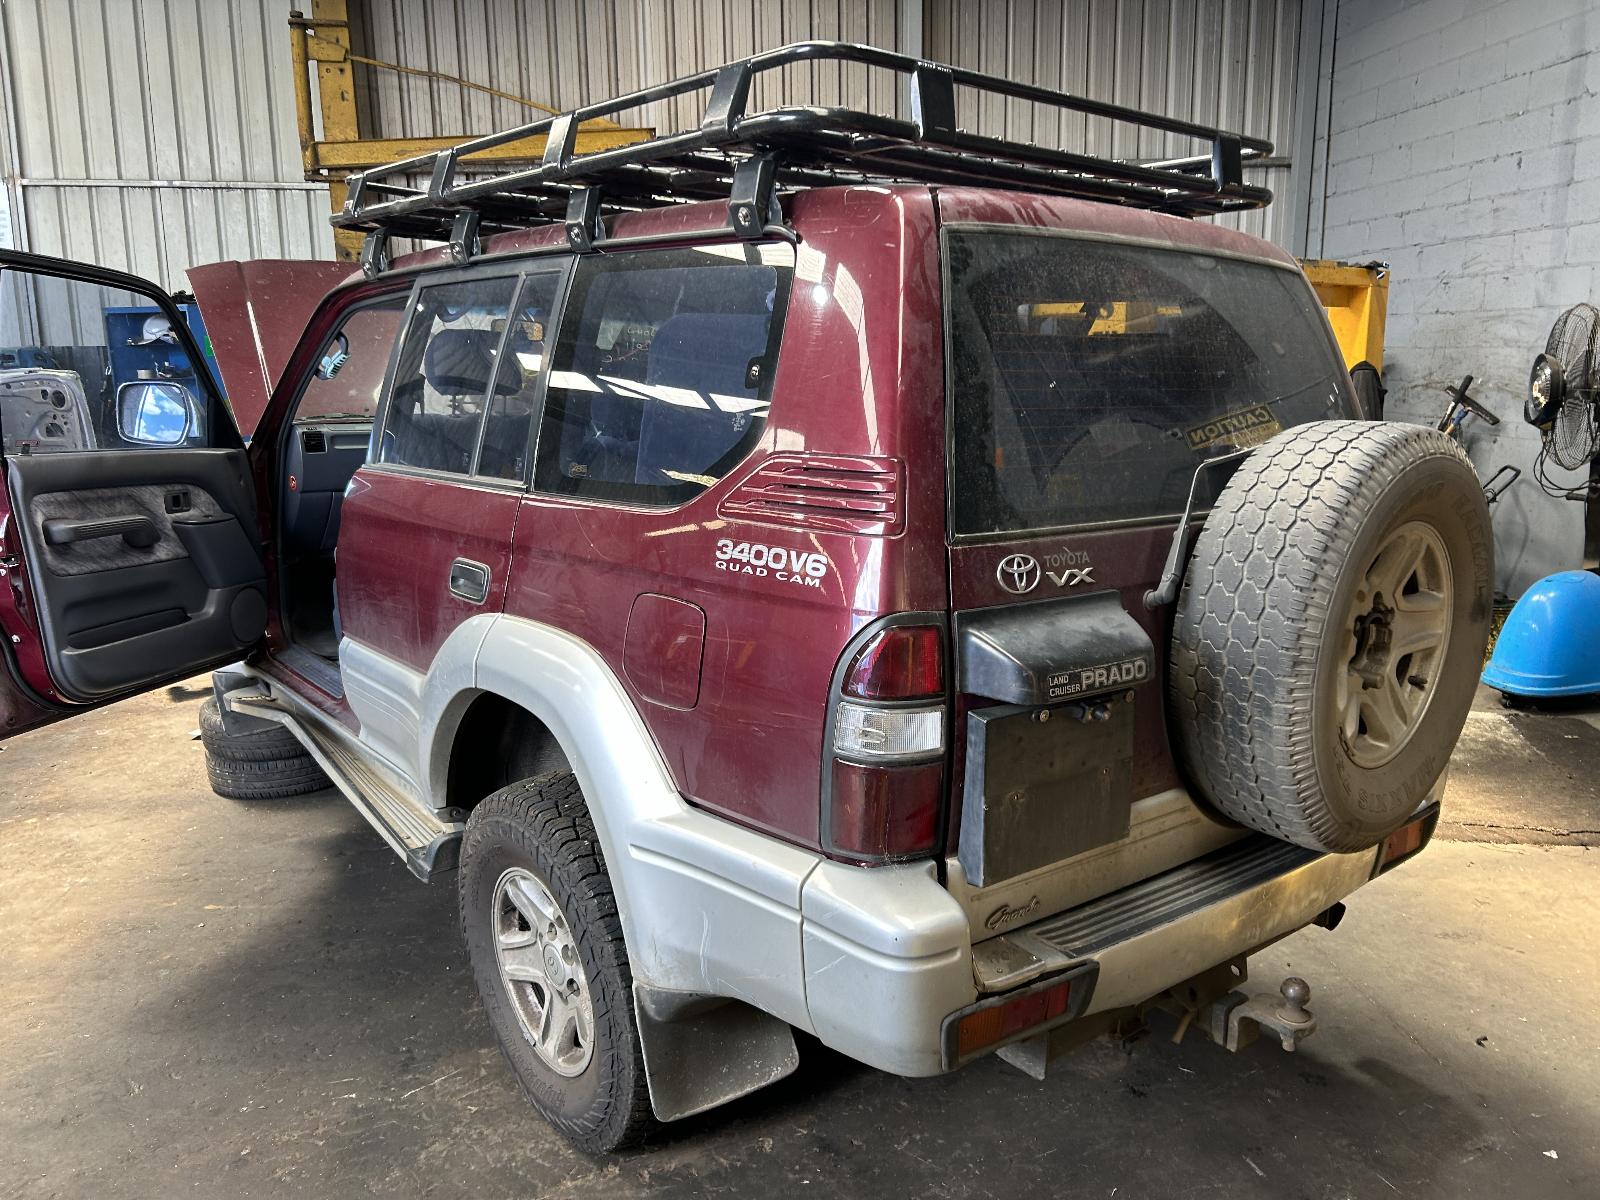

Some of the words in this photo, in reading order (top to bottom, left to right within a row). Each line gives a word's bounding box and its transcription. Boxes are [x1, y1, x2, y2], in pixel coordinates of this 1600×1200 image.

[1043, 551, 1091, 568] TOYOTA
[715, 560, 768, 576] QUAD
[775, 571, 821, 588] CAM
[1045, 567, 1096, 587] VX
[1049, 675, 1069, 687] LAND
[1080, 659, 1147, 691] PRADO
[1049, 684, 1081, 697] CRUISER
